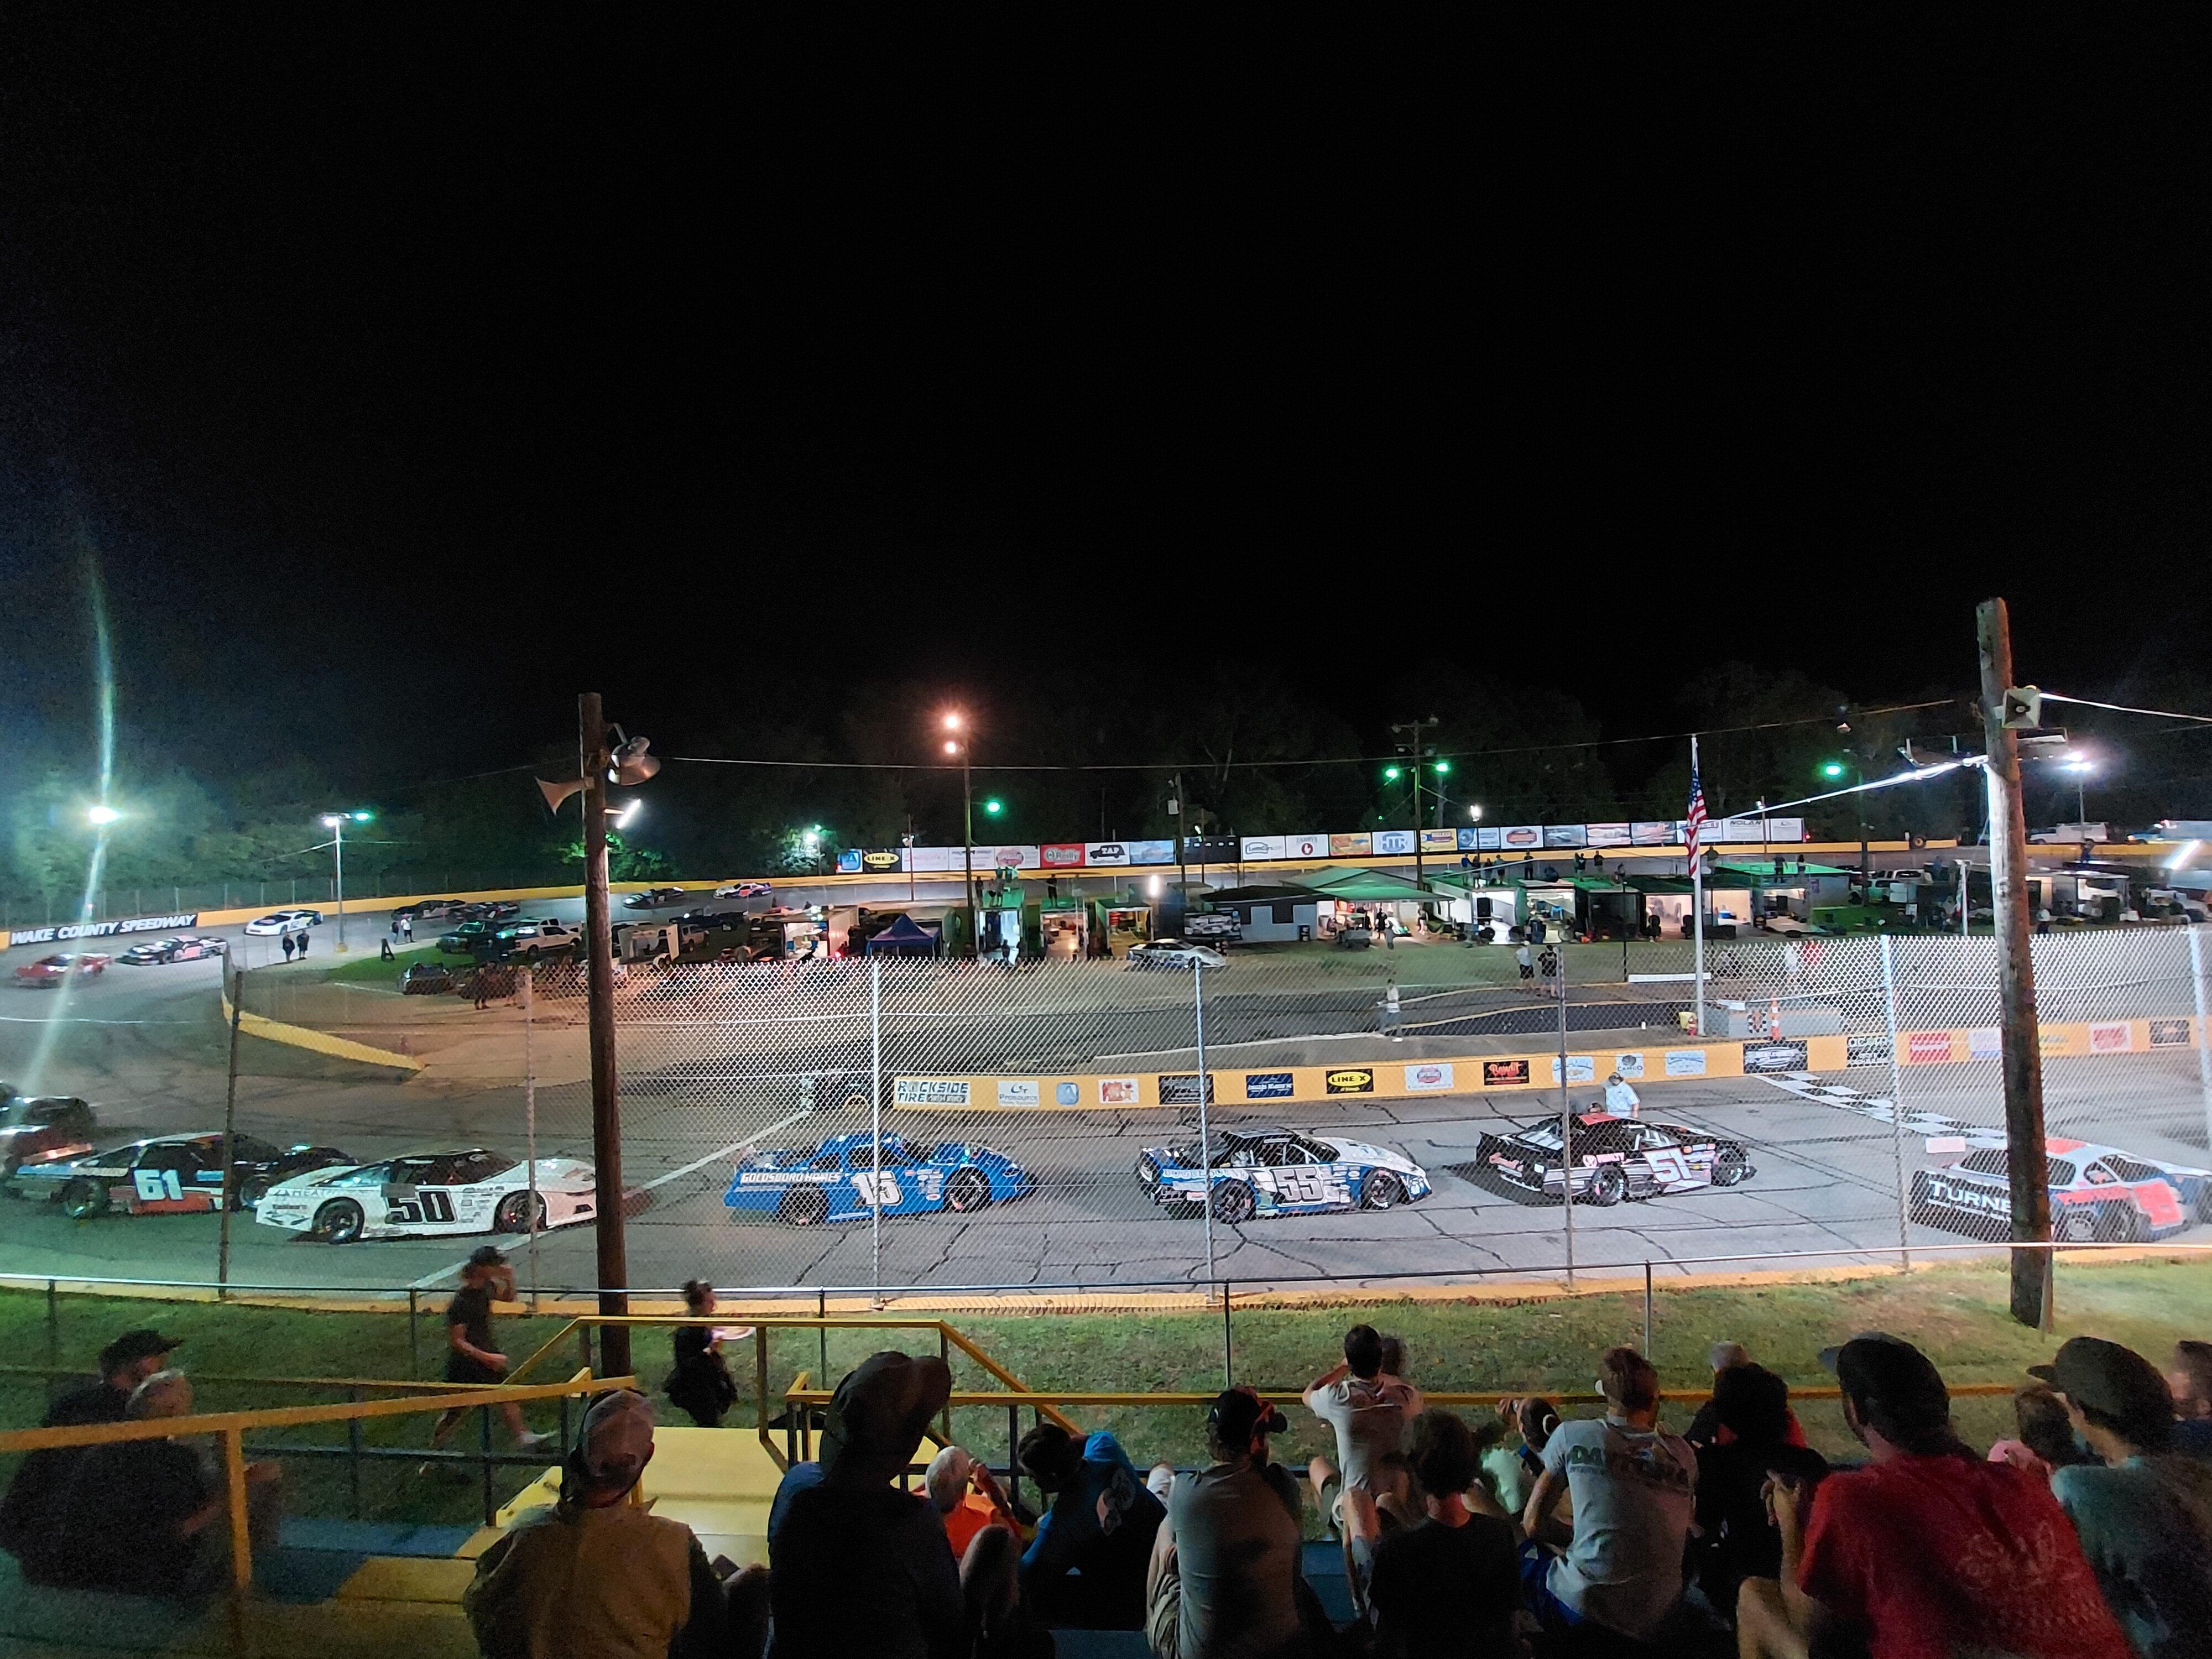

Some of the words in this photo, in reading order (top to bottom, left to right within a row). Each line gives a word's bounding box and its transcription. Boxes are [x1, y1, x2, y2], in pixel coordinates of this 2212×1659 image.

[11, 928, 55, 945] WAKE
[57, 922, 120, 940] COUNTY
[119, 914, 196, 933] SPEEDWAY
[898, 1081, 968, 1093] ROCKSIDE
[898, 1093, 926, 1103] TIRE
[1642, 1147, 1693, 1183] 51
[133, 1169, 184, 1201] 61
[851, 1171, 903, 1207] 15
[1269, 1167, 1324, 1203] 55
[1928, 1179, 2012, 1213] TURNE
[385, 1188, 458, 1225] 50
